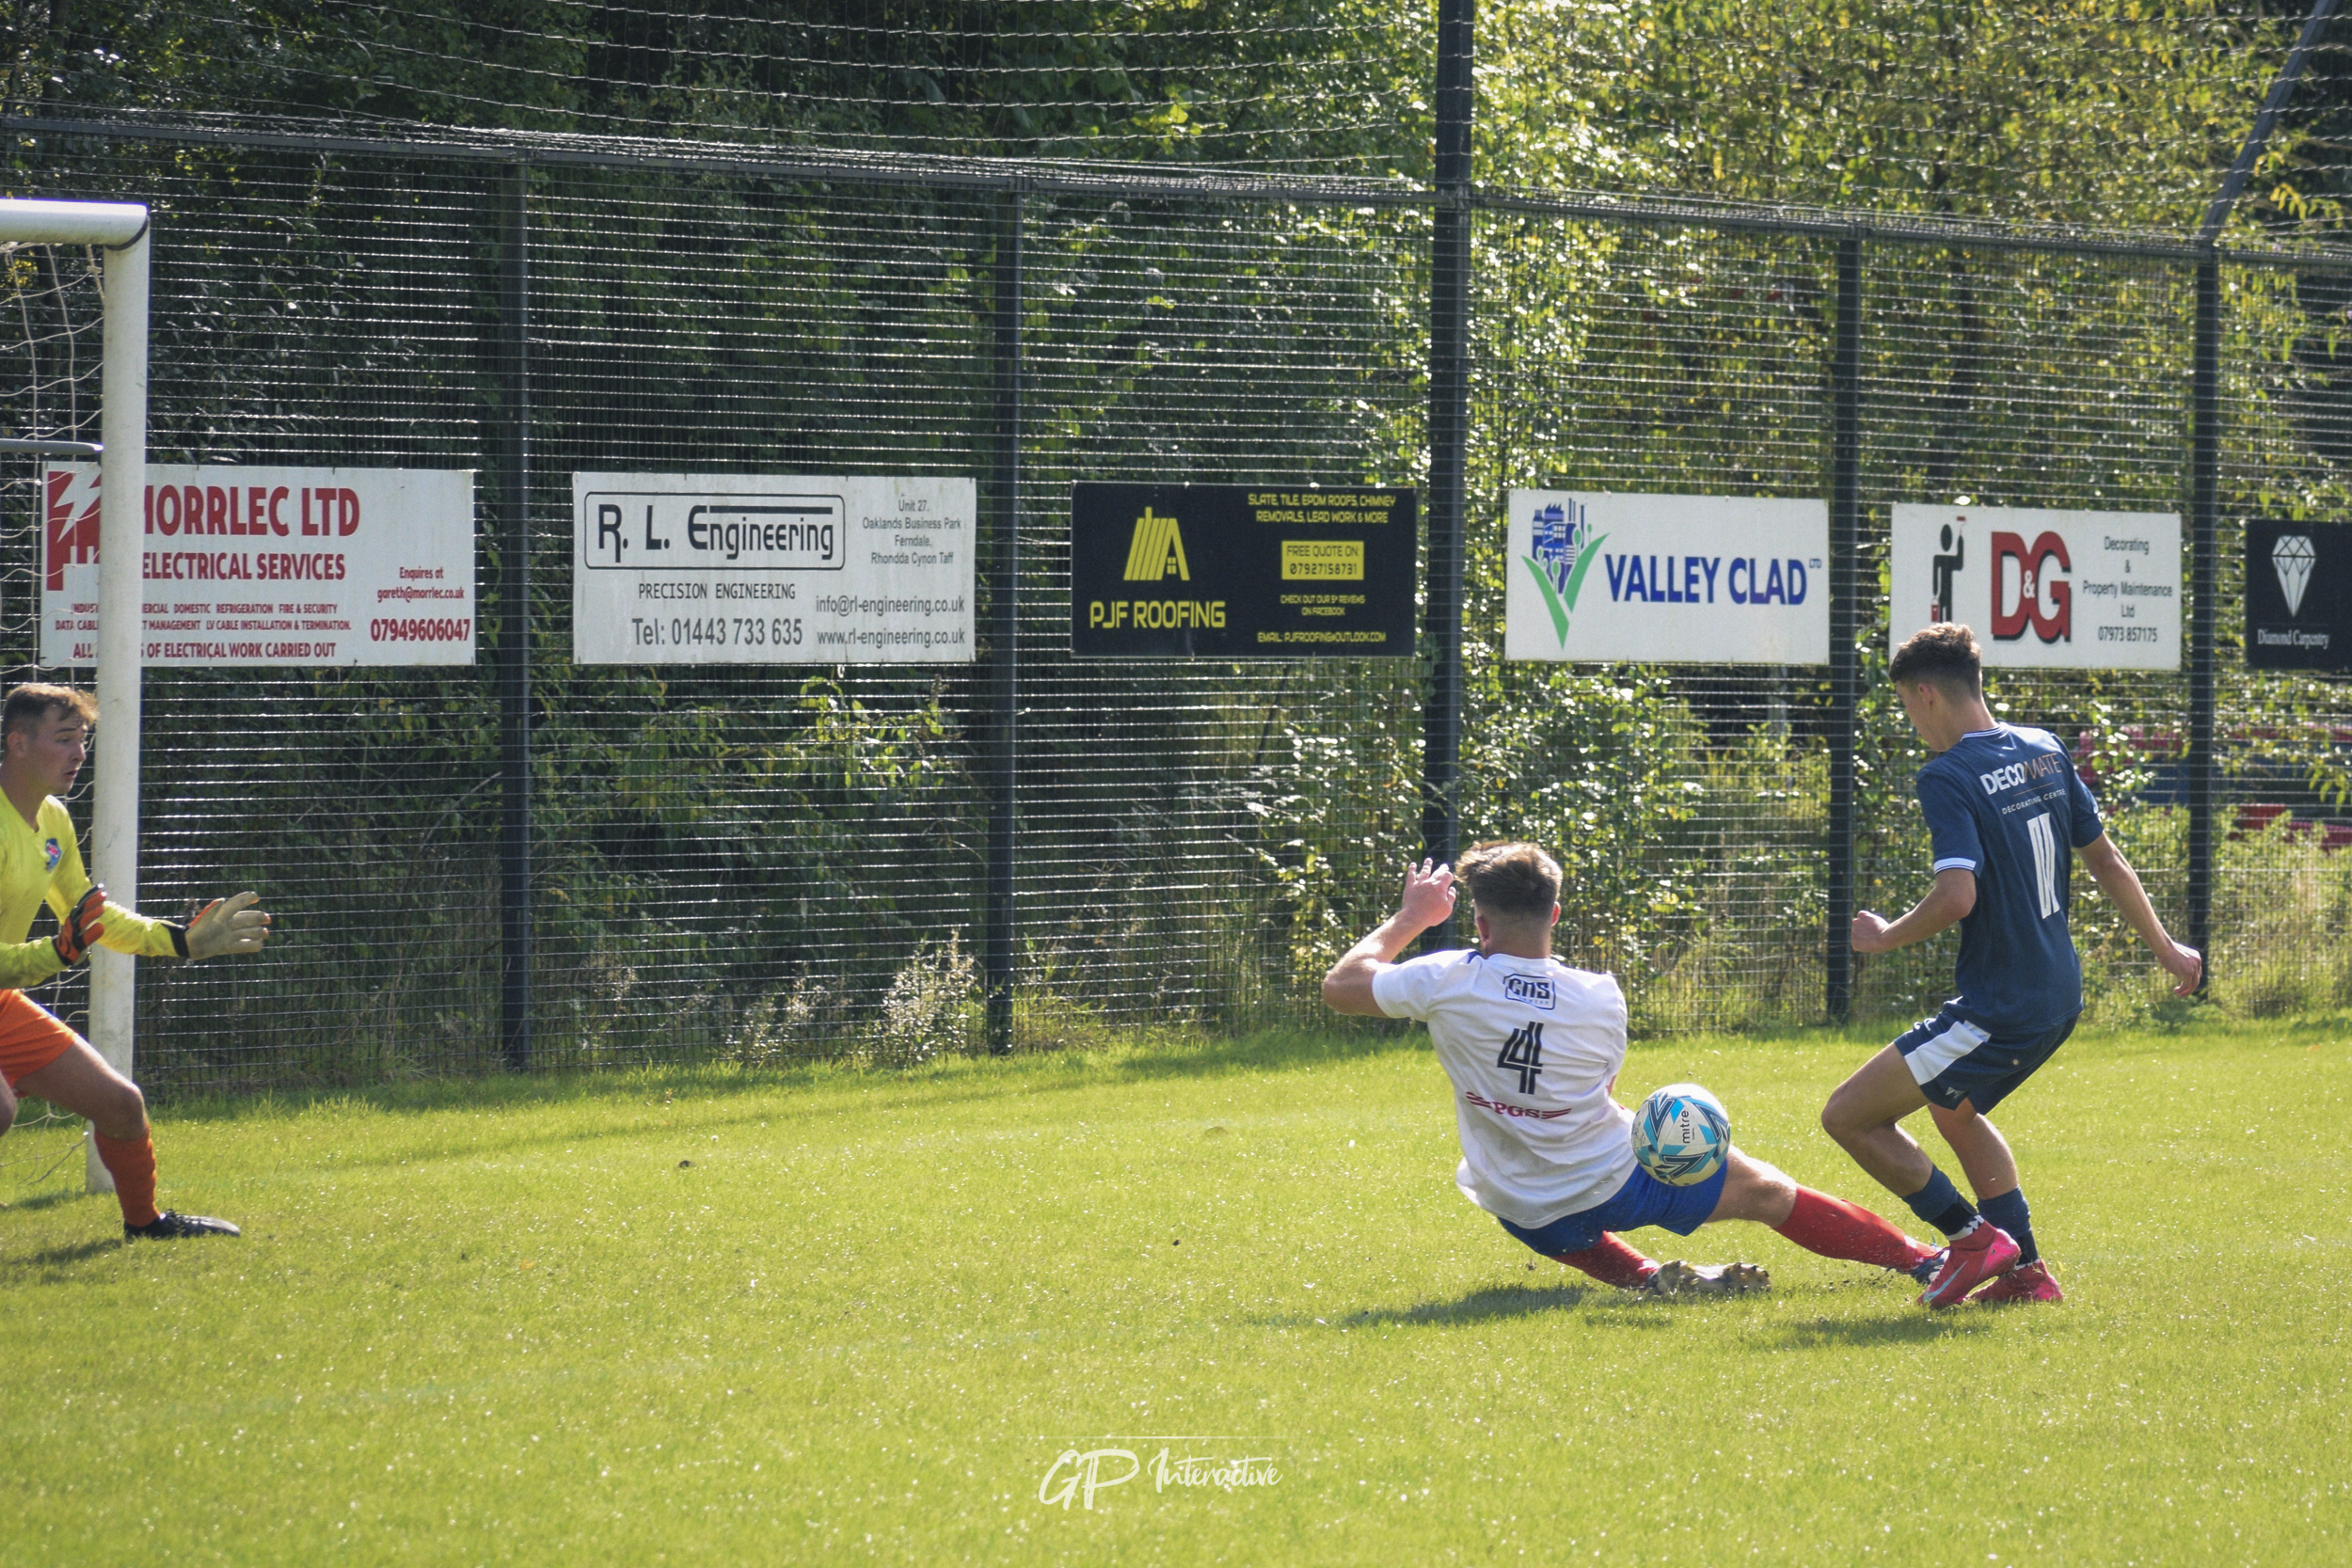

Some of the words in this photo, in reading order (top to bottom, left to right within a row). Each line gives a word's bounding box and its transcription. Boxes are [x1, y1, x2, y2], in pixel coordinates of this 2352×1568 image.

[898, 499, 916, 513] Unit
[1302, 494, 1327, 506] EPDM
[1359, 495, 1396, 507] CHIMNEY
[301, 487, 360, 536] LTD
[1307, 511, 1330, 523] LEAD
[1331, 511, 1357, 523] WORK
[1358, 513, 1364, 523] &
[1364, 512, 1389, 524] MORE
[862, 516, 903, 530] Oaklands
[905, 516, 942, 530] Business
[944, 517, 961, 530] Park
[598, 503, 628, 563] R.
[645, 504, 671, 550] L.
[687, 504, 834, 561] Engineering
[1287, 546, 1311, 557] FREE
[1312, 546, 1343, 558] QUOTE
[2104, 536, 2150, 555] Decorating
[142, 552, 252, 579] ELECTRICAL
[257, 553, 345, 580] SERVICES
[871, 551, 909, 564] Rhondda
[912, 552, 937, 567] Cynon
[939, 551, 954, 564] Taff
[2124, 559, 2131, 573] &
[399, 566, 434, 581] Enquires
[435, 567, 444, 579] at
[1290, 562, 1358, 575] 07927158731
[1604, 553, 1722, 604] VALLEY
[1728, 556, 1807, 606] CLAD
[377, 586, 464, 603] gareth@morrlec.co.uk
[639, 582, 707, 599] PRECISION
[716, 583, 796, 599] ENGINEERING
[2083, 579, 2118, 599] Property
[2121, 581, 2172, 596] Maintenance
[174, 603, 211, 614] DOMESTIC
[215, 603, 273, 614] REFRIGERATION
[278, 603, 294, 614] FIRE
[296, 604, 301, 614] &
[303, 604, 338, 614] SECURITY
[816, 594, 965, 617] info@rl-engineering.co.uk
[1089, 600, 1129, 628] PJF
[1134, 600, 1226, 628] ROOFING
[2121, 604, 2135, 618] Ltd
[56, 620, 73, 630] DATA
[149, 620, 201, 630] MANAGEMENT
[206, 620, 215, 630] LV
[216, 620, 239, 630] CABLE
[241, 620, 292, 630] INSTALLATION
[294, 621, 299, 630] &
[371, 618, 470, 641] 07949606047
[631, 617, 666, 645] Tel:
[672, 617, 726, 645] 01443
[733, 617, 765, 645] 733
[771, 617, 803, 645] 635
[2098, 626, 2124, 641] 07973
[2126, 626, 2157, 642] 857175
[817, 627, 965, 649] www.rl-engineering.co.uk
[2257, 628, 2292, 645] Diamond
[2293, 629, 2329, 650] Carpentry
[72, 642, 93, 658] ALL
[147, 642, 161, 658] OF
[165, 642, 227, 658] ELECTRICAL
[229, 642, 262, 657] WORK
[265, 642, 311, 657] CARRIED
[314, 642, 337, 657] OUT
[1979, 752, 2062, 795] DECOMATE
[2001, 796, 2042, 816] DECORATING
[2043, 788, 2066, 801] CENTRE
[2026, 812, 2060, 920] 11
[1497, 1021, 1545, 1095] 4
[1491, 1101, 1541, 1119] PGS
[1679, 1110, 1691, 1144] mitre
